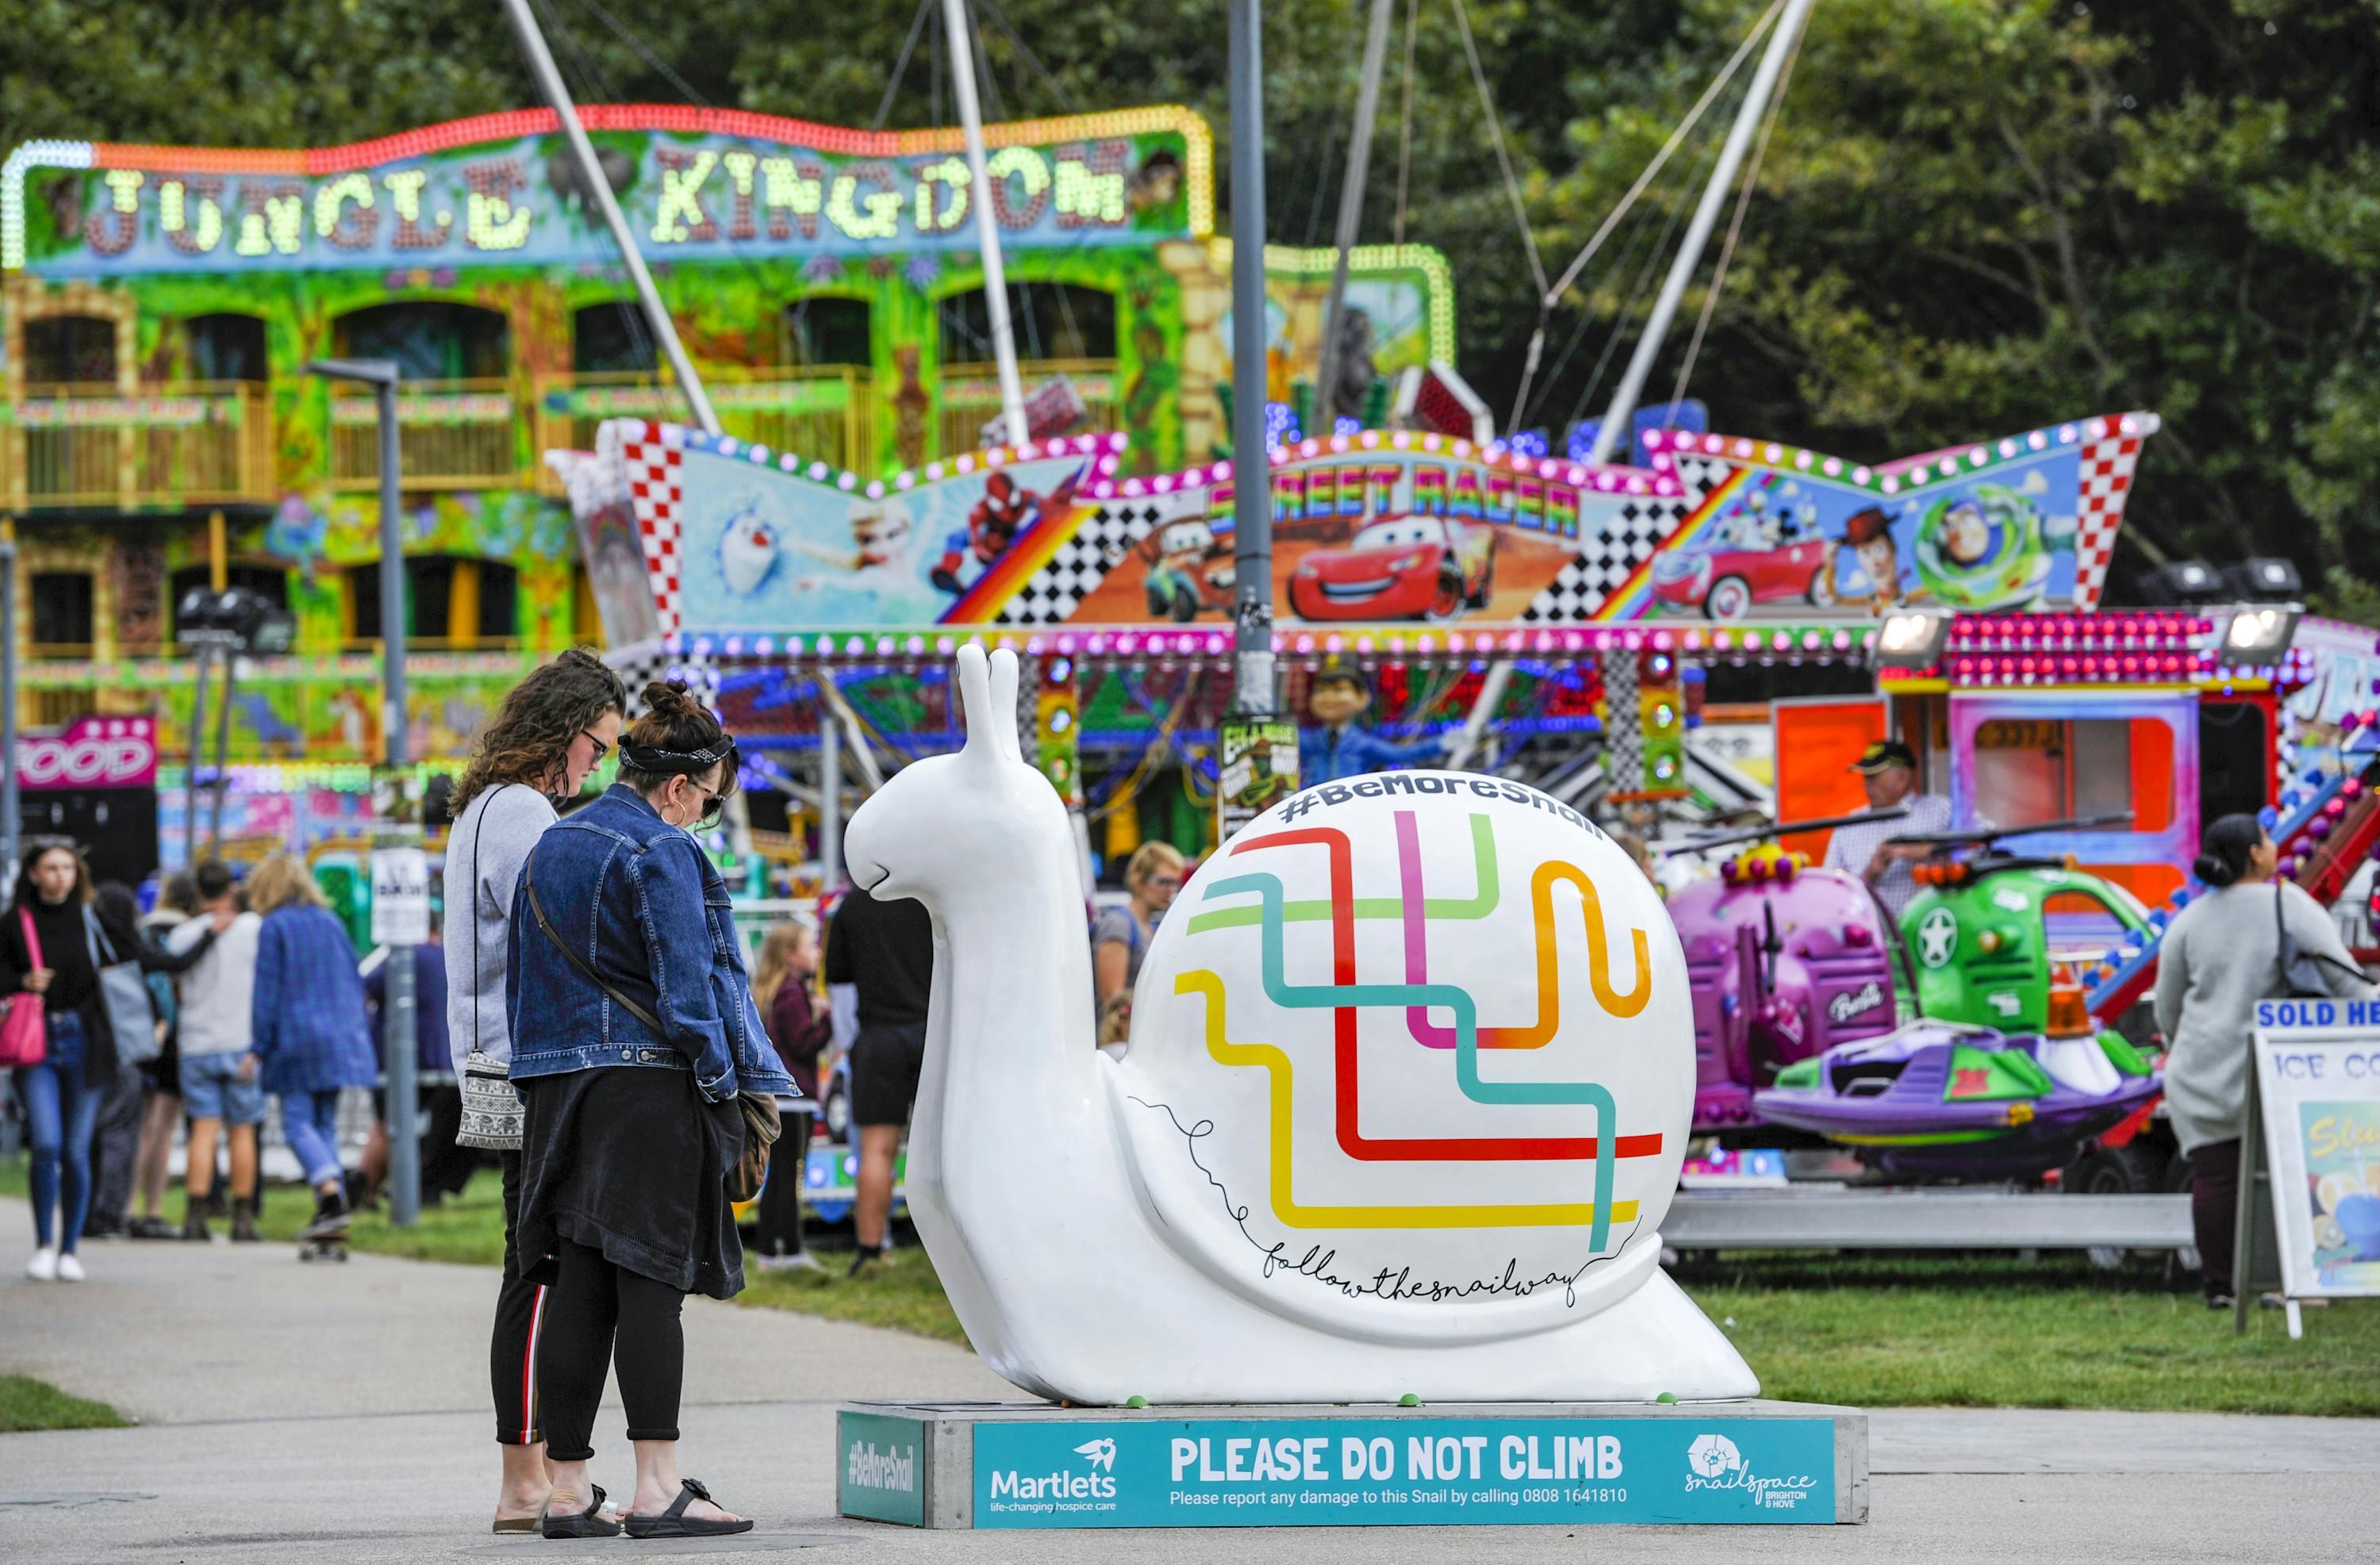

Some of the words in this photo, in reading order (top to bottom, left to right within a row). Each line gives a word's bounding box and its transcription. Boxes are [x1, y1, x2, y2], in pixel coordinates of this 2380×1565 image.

[83, 160, 532, 258] JUNGLE
[650, 138, 1131, 243] KINGDOM
[1207, 462, 1403, 535] SREET
[1412, 462, 1581, 539] RACER
[1277, 774, 1604, 841] #BeMoreSnail
[2258, 1002, 2336, 1027] SOLD
[2274, 1053, 2325, 1079] ICE
[1263, 1241, 1579, 1309] followthesnailway
[848, 1440, 913, 1492] #BeMoreSnail
[1171, 1437, 1330, 1482] PLEASE
[1342, 1437, 1395, 1481] DO
[1407, 1437, 1488, 1481] NOT
[1499, 1435, 1623, 1480] CLIMB
[991, 1470, 1116, 1498] Martlets
[1170, 1491, 1219, 1505] Please
[1223, 1491, 1267, 1507] report
[1270, 1494, 1296, 1507] any
[1299, 1490, 1359, 1506] damage
[1362, 1491, 1377, 1504] to
[1381, 1489, 1408, 1504] this
[1411, 1489, 1447, 1503] Snail
[1451, 1489, 1468, 1506] by
[1472, 1489, 1519, 1506] calling
[1522, 1488, 1559, 1503] 0808
[1564, 1488, 1627, 1503] 1641810
[1684, 1459, 1818, 1506] snailspace
[1765, 1490, 1807, 1500] BRIGHTON
[990, 1502, 1054, 1514] life-changing
[1055, 1502, 1093, 1513] hospice
[1095, 1502, 1117, 1511] care
[1765, 1499, 1772, 1509] &
[1773, 1499, 1795, 1509] HOVE
